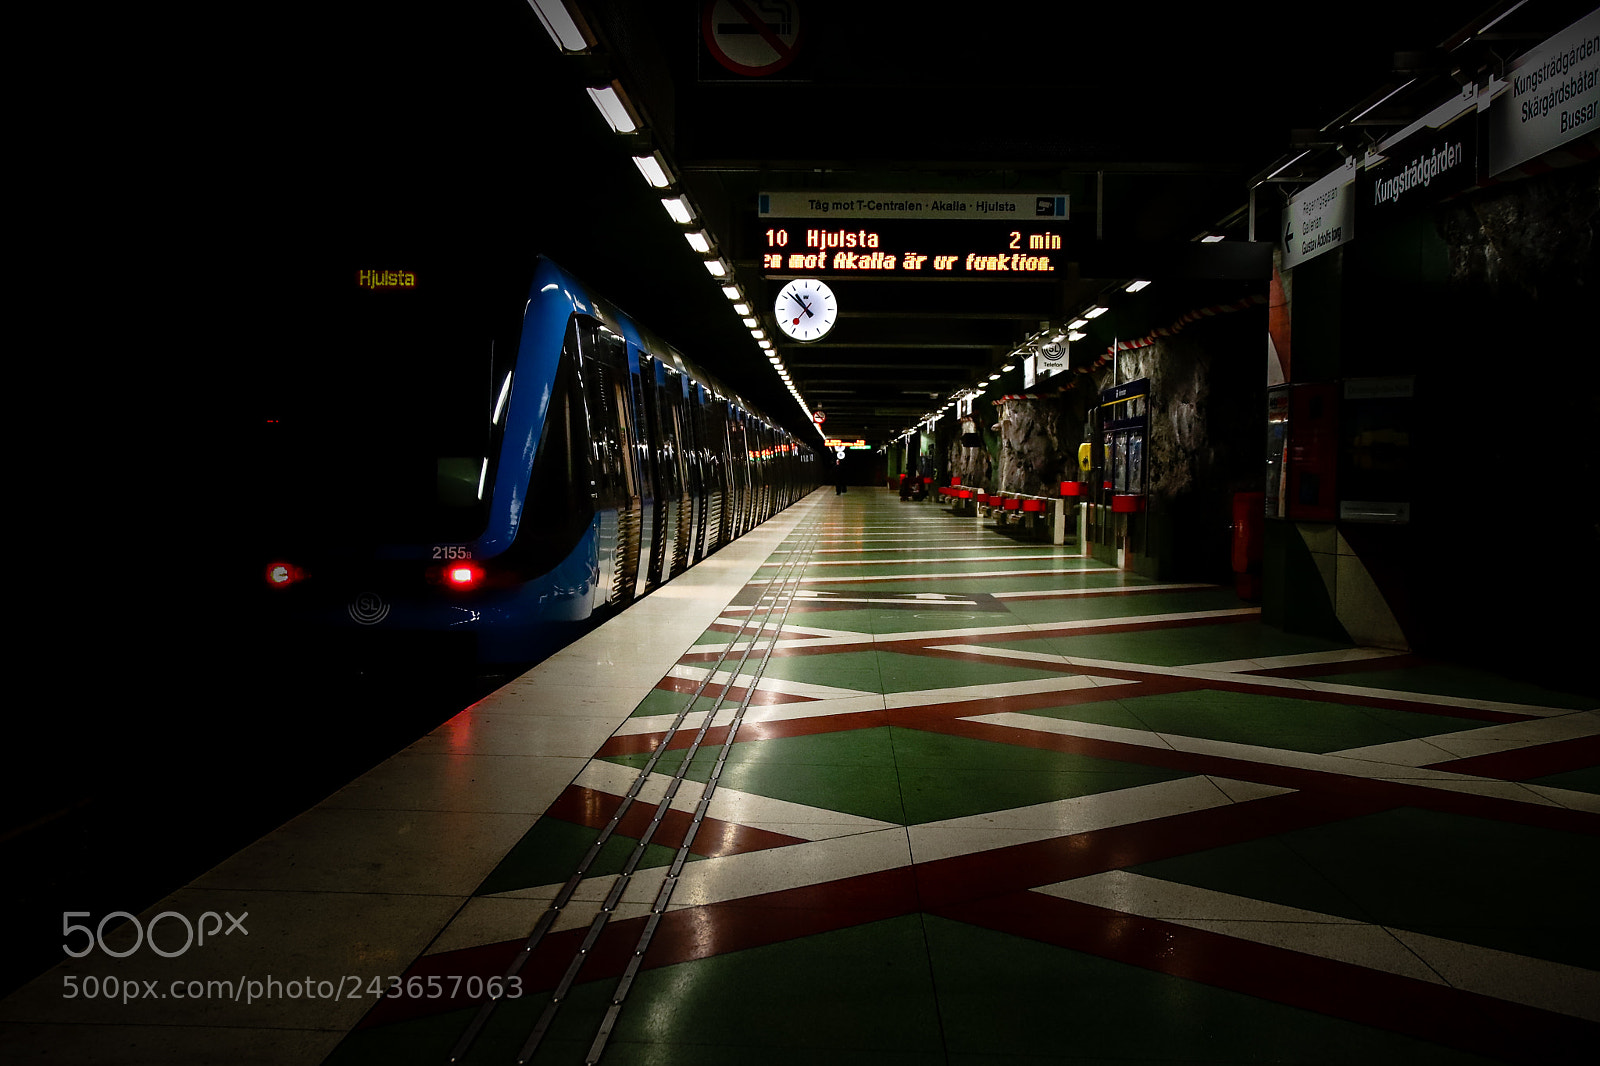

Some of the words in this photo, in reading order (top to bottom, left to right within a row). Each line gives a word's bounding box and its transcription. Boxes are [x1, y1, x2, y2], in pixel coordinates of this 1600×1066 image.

[1513, 35, 1600, 98] Kungsträdgården
[1521, 66, 1599, 123] Skärgårdsbåtar
[1560, 100, 1599, 134] Bussar
[1374, 141, 1462, 206] Kungsträdgården
[808, 199, 829, 212] Tåg
[831, 200, 855, 211] mot
[856, 199, 922, 212] T-Centralen
[931, 200, 966, 212] Akalla
[976, 200, 1016, 213] Hjulsta
[765, 229, 788, 247] 10
[807, 229, 879, 250] Hjulsta
[1009, 231, 1021, 249] 2
[1029, 231, 1062, 250] min
[788, 251, 828, 269] mot
[833, 251, 897, 270] Akalla
[902, 252, 928, 270] är
[933, 255, 959, 270] ur
[965, 252, 1055, 271] funktion.
[358, 268, 416, 290] Hjulsta
